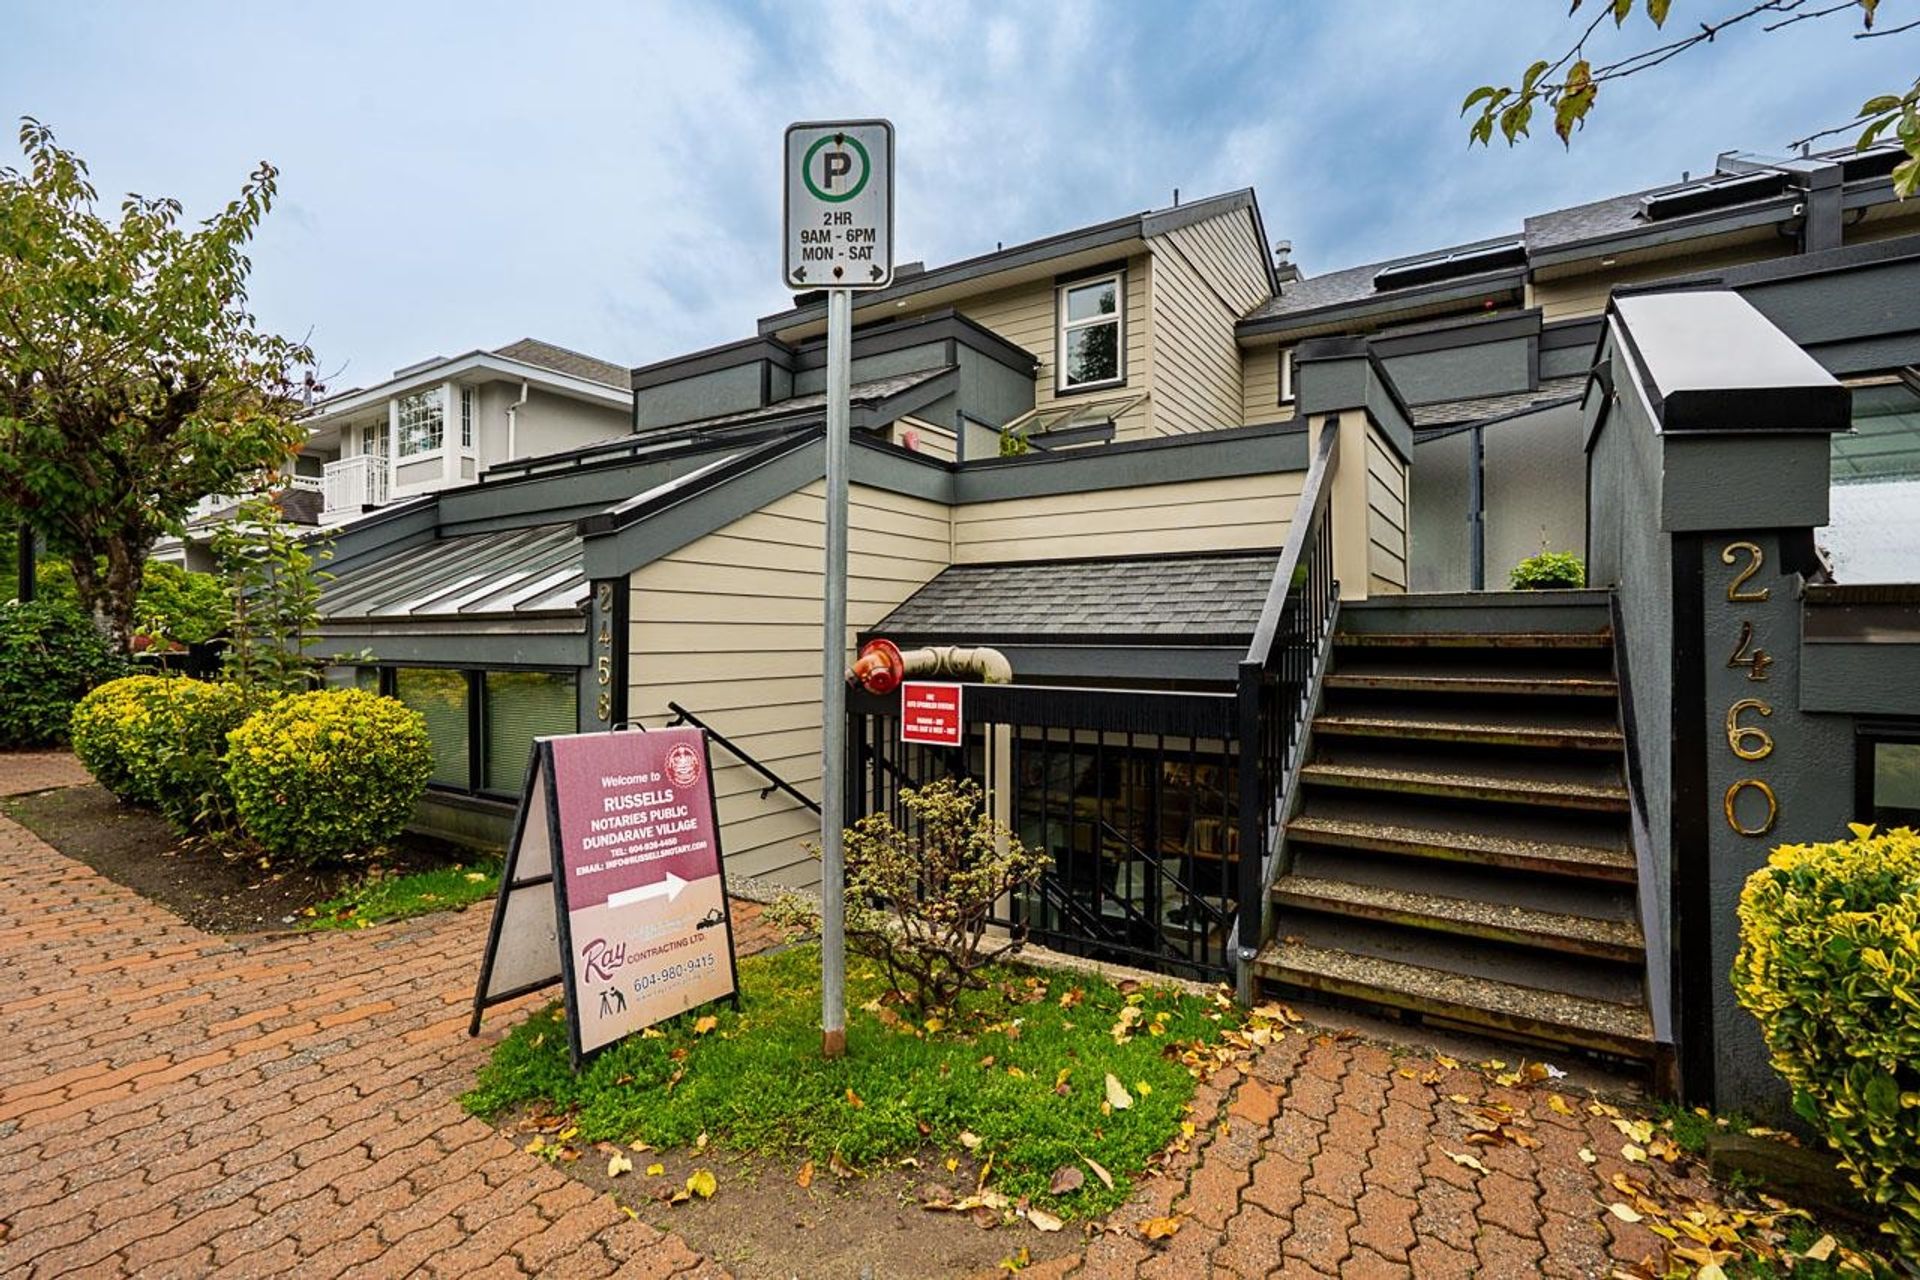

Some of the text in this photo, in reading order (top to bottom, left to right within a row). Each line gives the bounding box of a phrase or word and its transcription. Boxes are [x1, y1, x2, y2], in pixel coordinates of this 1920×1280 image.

[824, 152, 852, 189] P
[823, 211, 852, 226] 2 HR
[800, 229, 831, 244] 9AM
[846, 228, 876, 243] 6PM
[802, 247, 834, 261] MON
[848, 246, 874, 260] SAT
[1721, 541, 1777, 838] 2460
[601, 772, 661, 788] Welcome to
[604, 789, 674, 812] RUSSELLS
[591, 805, 688, 832] NOTARIES PUBLIC
[582, 818, 698, 850] DUNDARAVE VILLAGE
[610, 847, 627, 858] TEL:
[575, 864, 604, 876] EMAIL:
[582, 938, 626, 984] Ray
[627, 937, 689, 965] CONTRACTING
[689, 932, 705, 945] LTD
